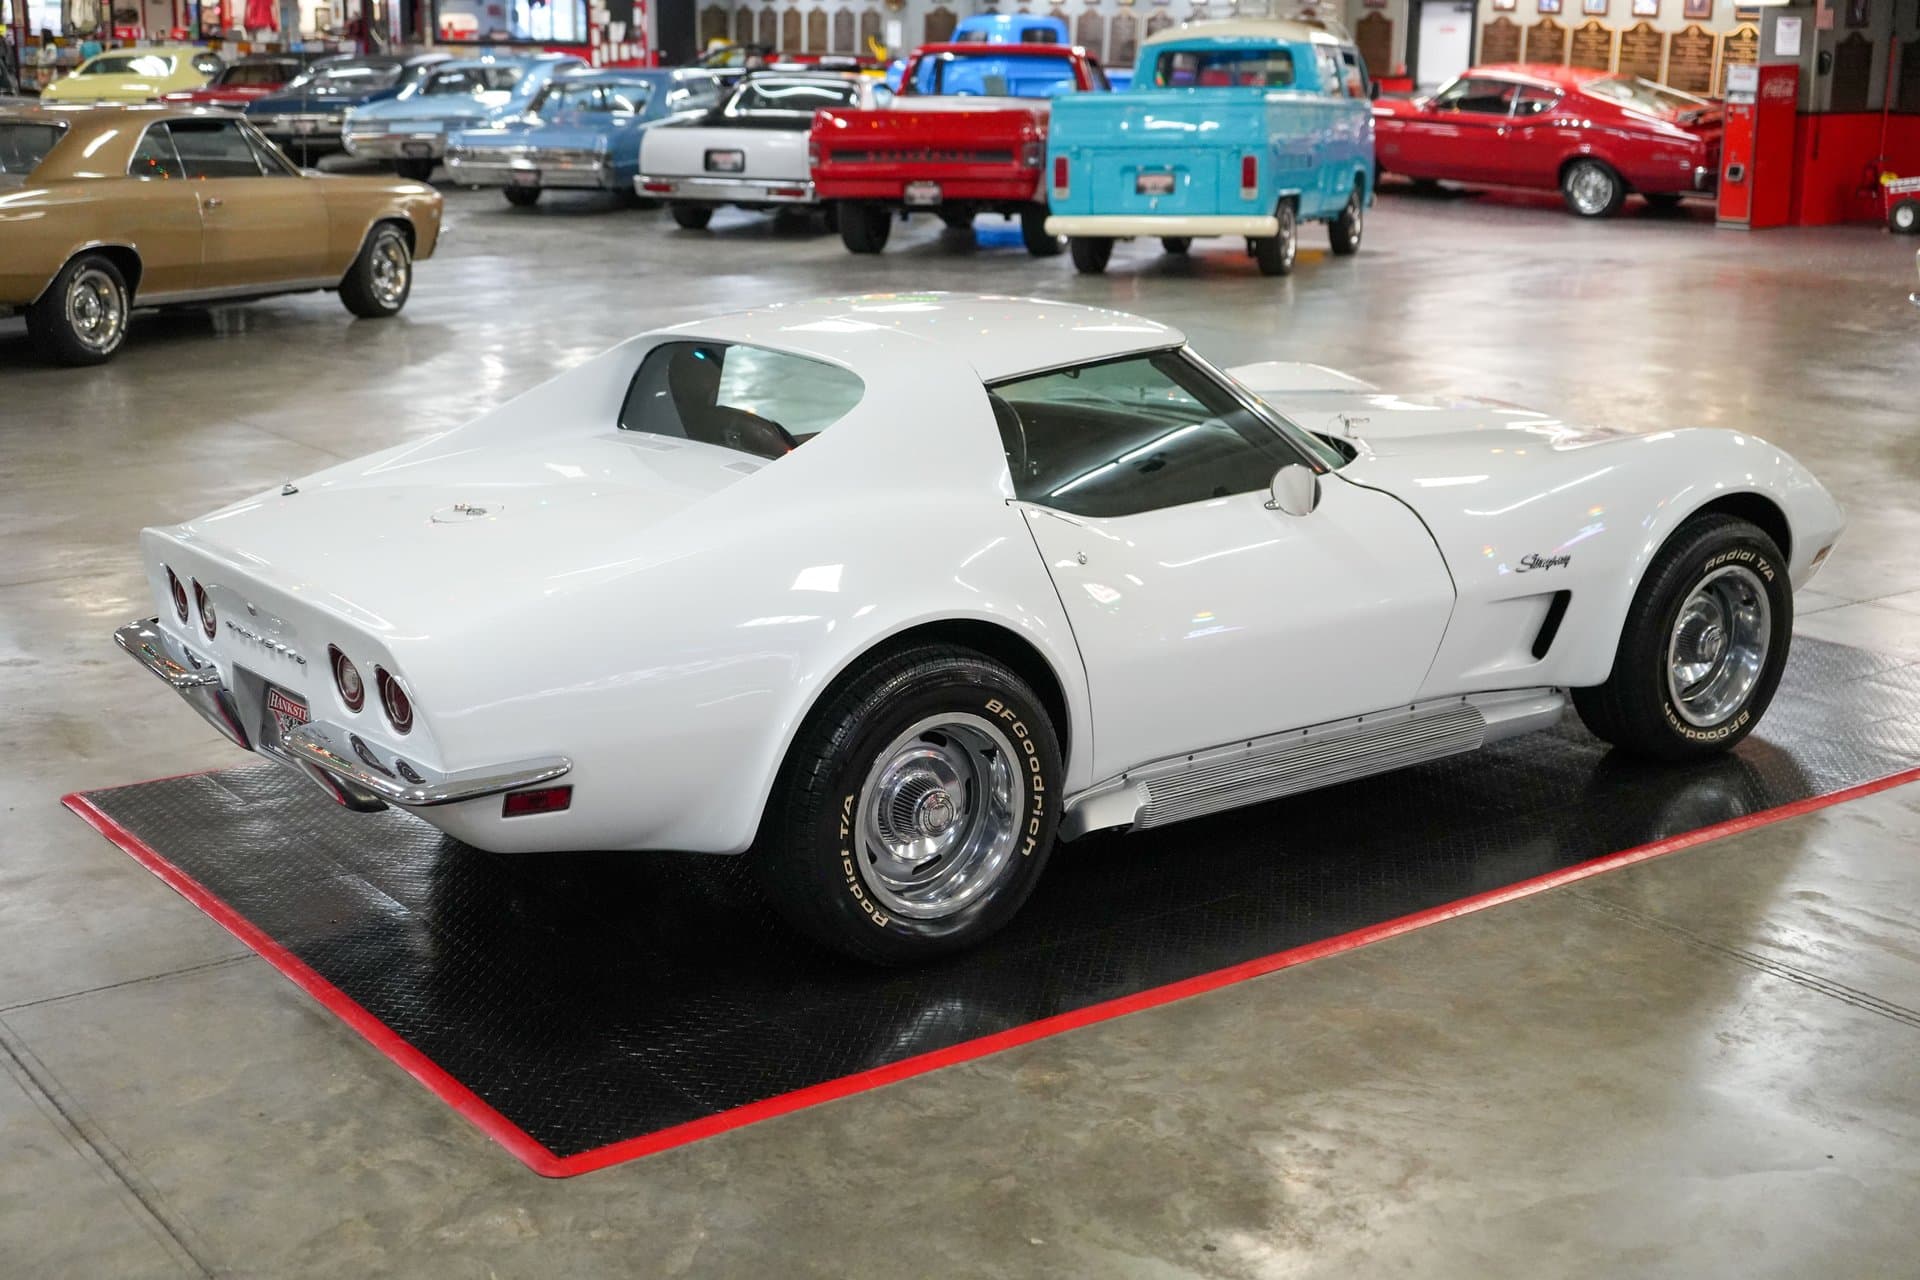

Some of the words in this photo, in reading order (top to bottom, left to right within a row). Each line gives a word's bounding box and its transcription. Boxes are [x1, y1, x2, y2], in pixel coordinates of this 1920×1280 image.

[1704, 549, 1756, 572] Radial
[1757, 557, 1775, 582] T/A
[1664, 702, 1750, 740] BFGoodrich
[983, 698, 1045, 857] BFGoodrich
[839, 794, 855, 840] T/A
[841, 849, 889, 927] Radial
